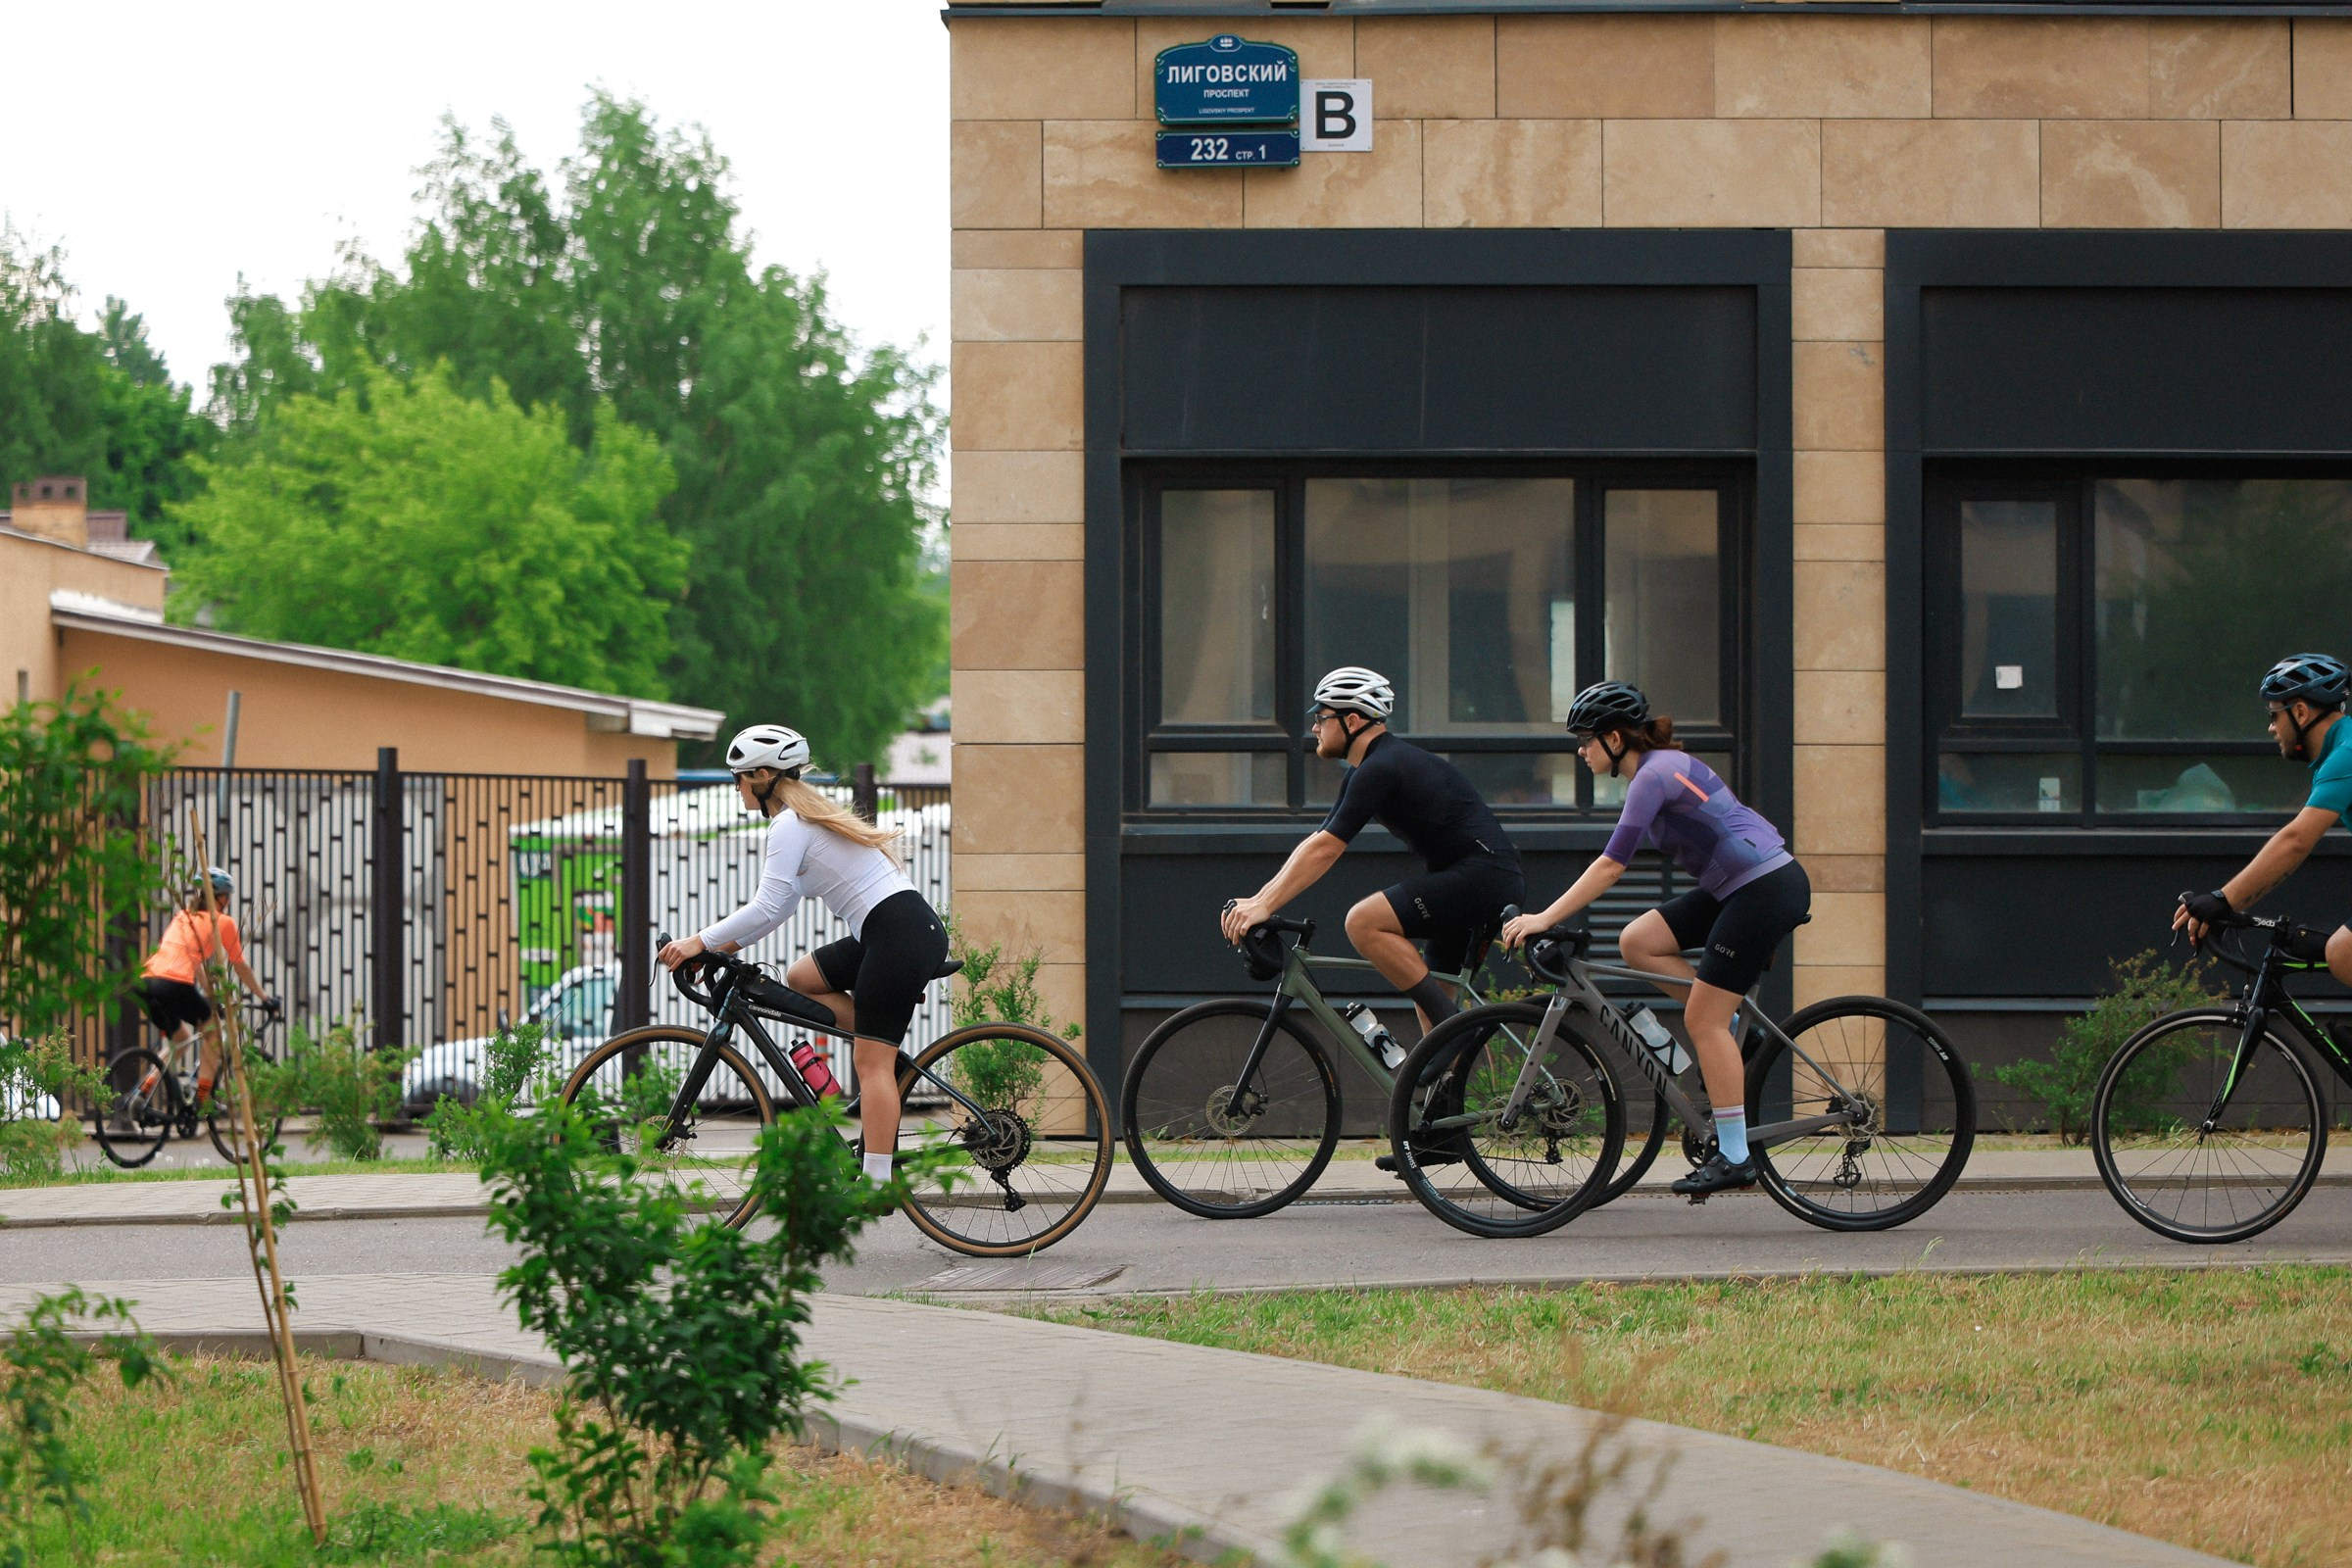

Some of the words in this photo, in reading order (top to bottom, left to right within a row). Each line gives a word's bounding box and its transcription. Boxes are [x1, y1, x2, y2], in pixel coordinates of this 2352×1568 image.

[1167, 60, 1287, 83] ЛИГОВСКИЙ
[1203, 88, 1250, 99] ПРОСПЕКТ
[1191, 138, 1229, 161] 232
[1258, 144, 1266, 160] 1
[1414, 897, 1431, 919] GORE
[1714, 943, 1736, 958] GORE
[749, 1004, 782, 1017] cannondale
[1600, 1004, 1667, 1097] CANYON
[1402, 1140, 1411, 1152] DT
[1405, 1152, 1417, 1169] SWISS
